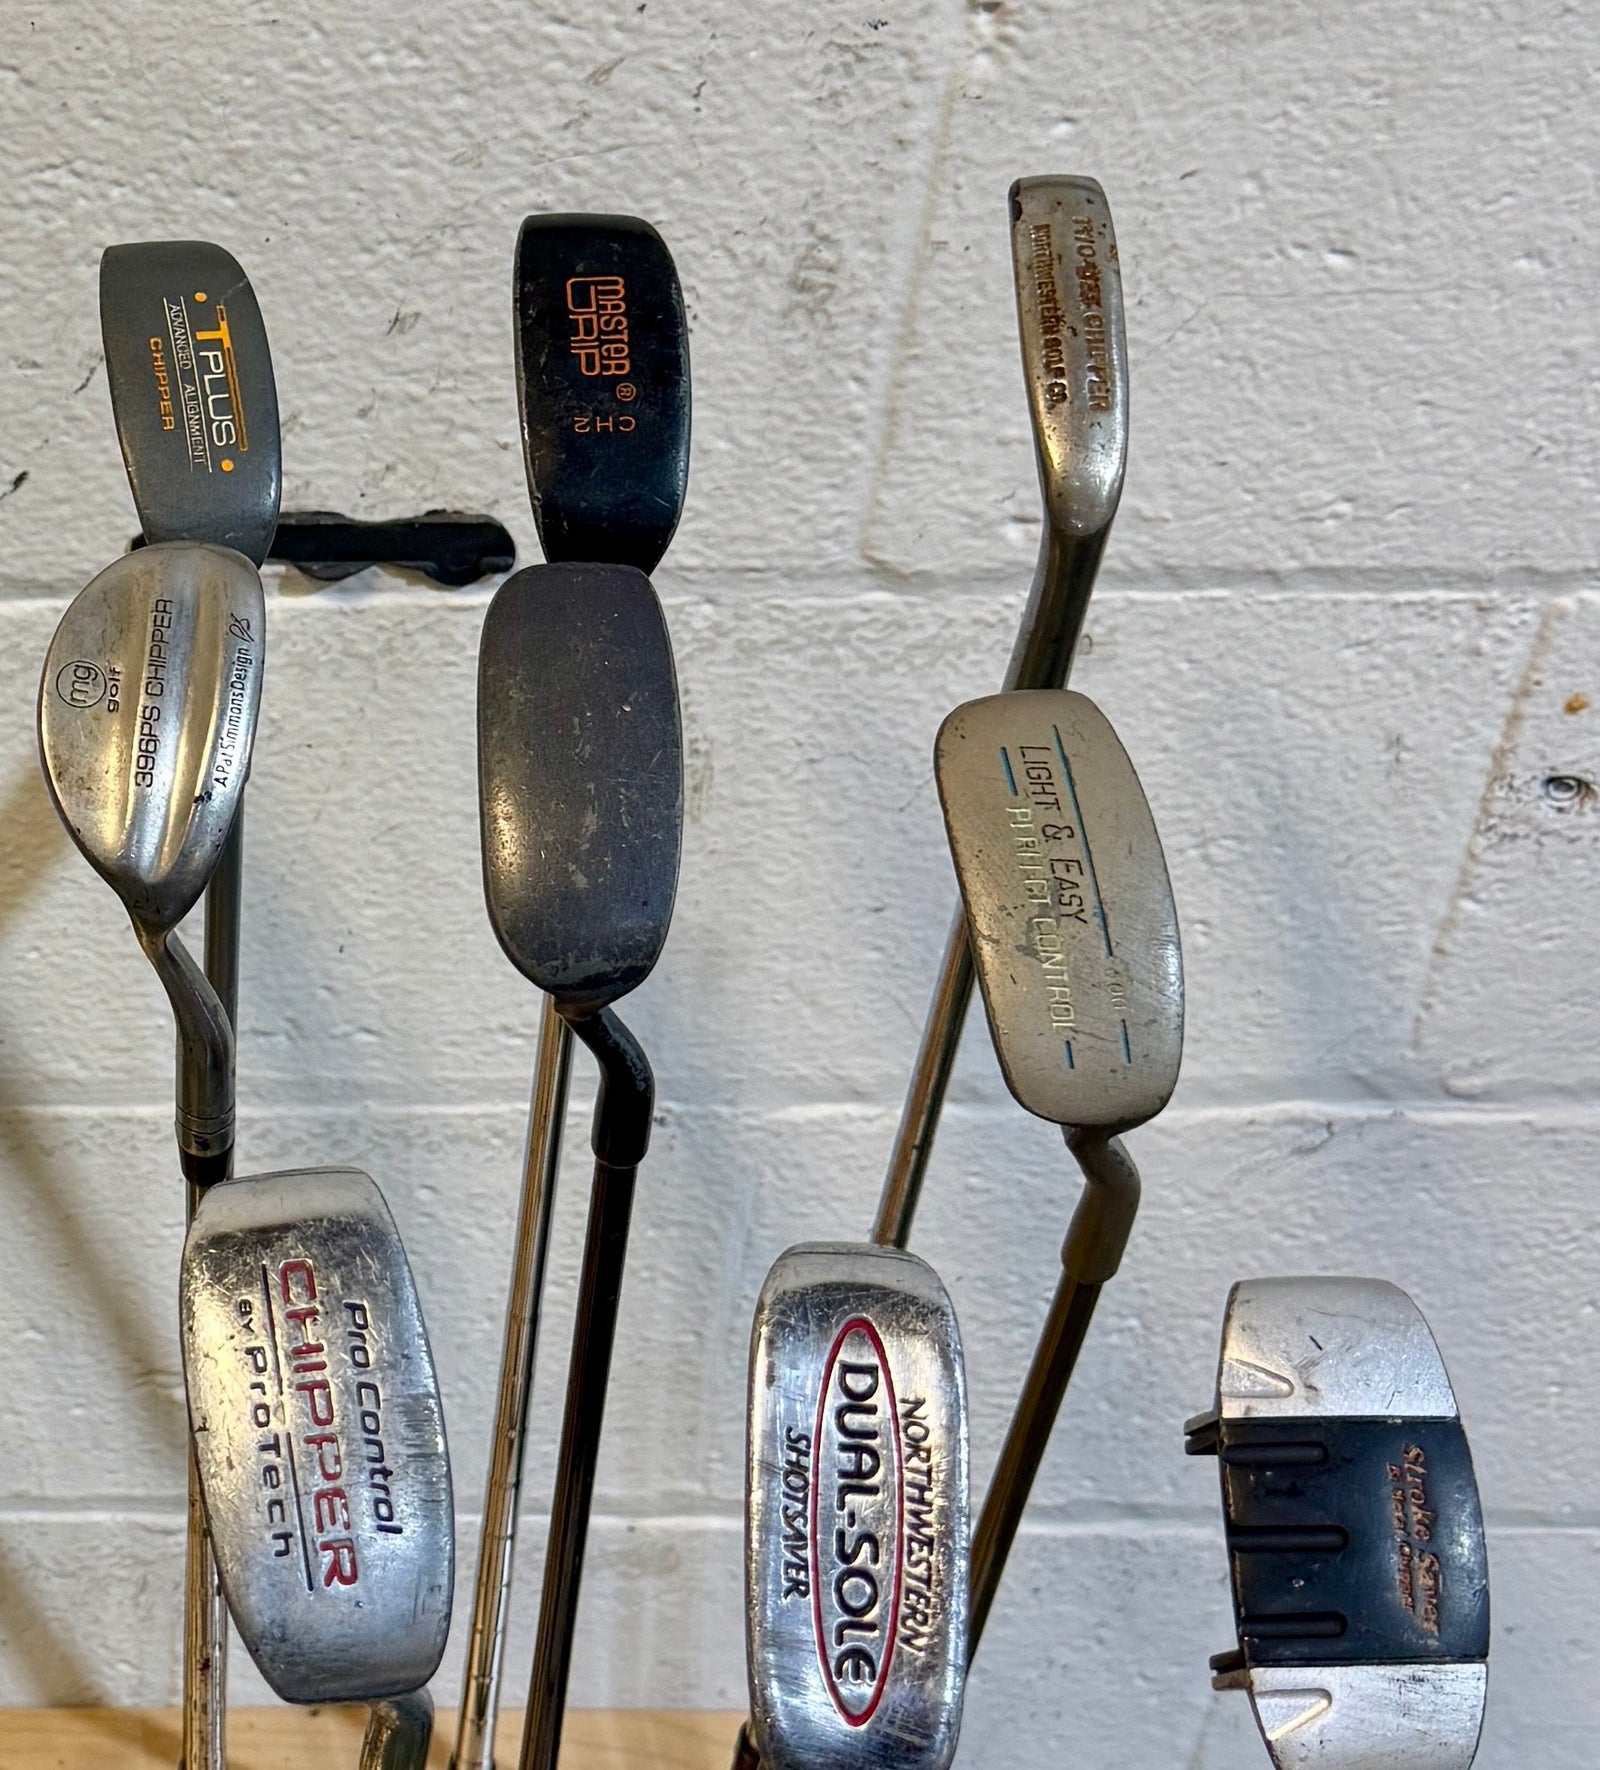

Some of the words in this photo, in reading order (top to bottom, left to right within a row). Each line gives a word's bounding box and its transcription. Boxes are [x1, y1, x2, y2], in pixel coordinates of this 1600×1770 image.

[566, 276, 601, 376] GRIP
[1082, 312, 1112, 412] CHIPPER
[149, 336, 175, 431] CHIPPER
[169, 303, 191, 370] ADVANCED
[184, 384, 207, 465] ALIGNMENT
[199, 351, 236, 447] PLUS
[69, 664, 98, 705] mg
[107, 667, 123, 714] golf
[146, 598, 174, 697] CHIPPER
[230, 646, 254, 691] Design
[135, 703, 161, 788] 396PS
[215, 752, 234, 778] Pat
[220, 691, 246, 751] Simmons
[1019, 745, 1062, 812] LIGHT
[1041, 823, 1076, 844] &
[1050, 857, 1088, 925] EASY
[1032, 917, 1077, 1031] CONTROL
[238, 1298, 254, 1335] BY
[278, 1257, 360, 1590] CHIPPER
[342, 1298, 372, 1370] Pro
[357, 1380, 403, 1536] Control
[832, 1359, 882, 1686] DUAL-SOLE
[899, 1398, 934, 1657] NORTHWESTERN
